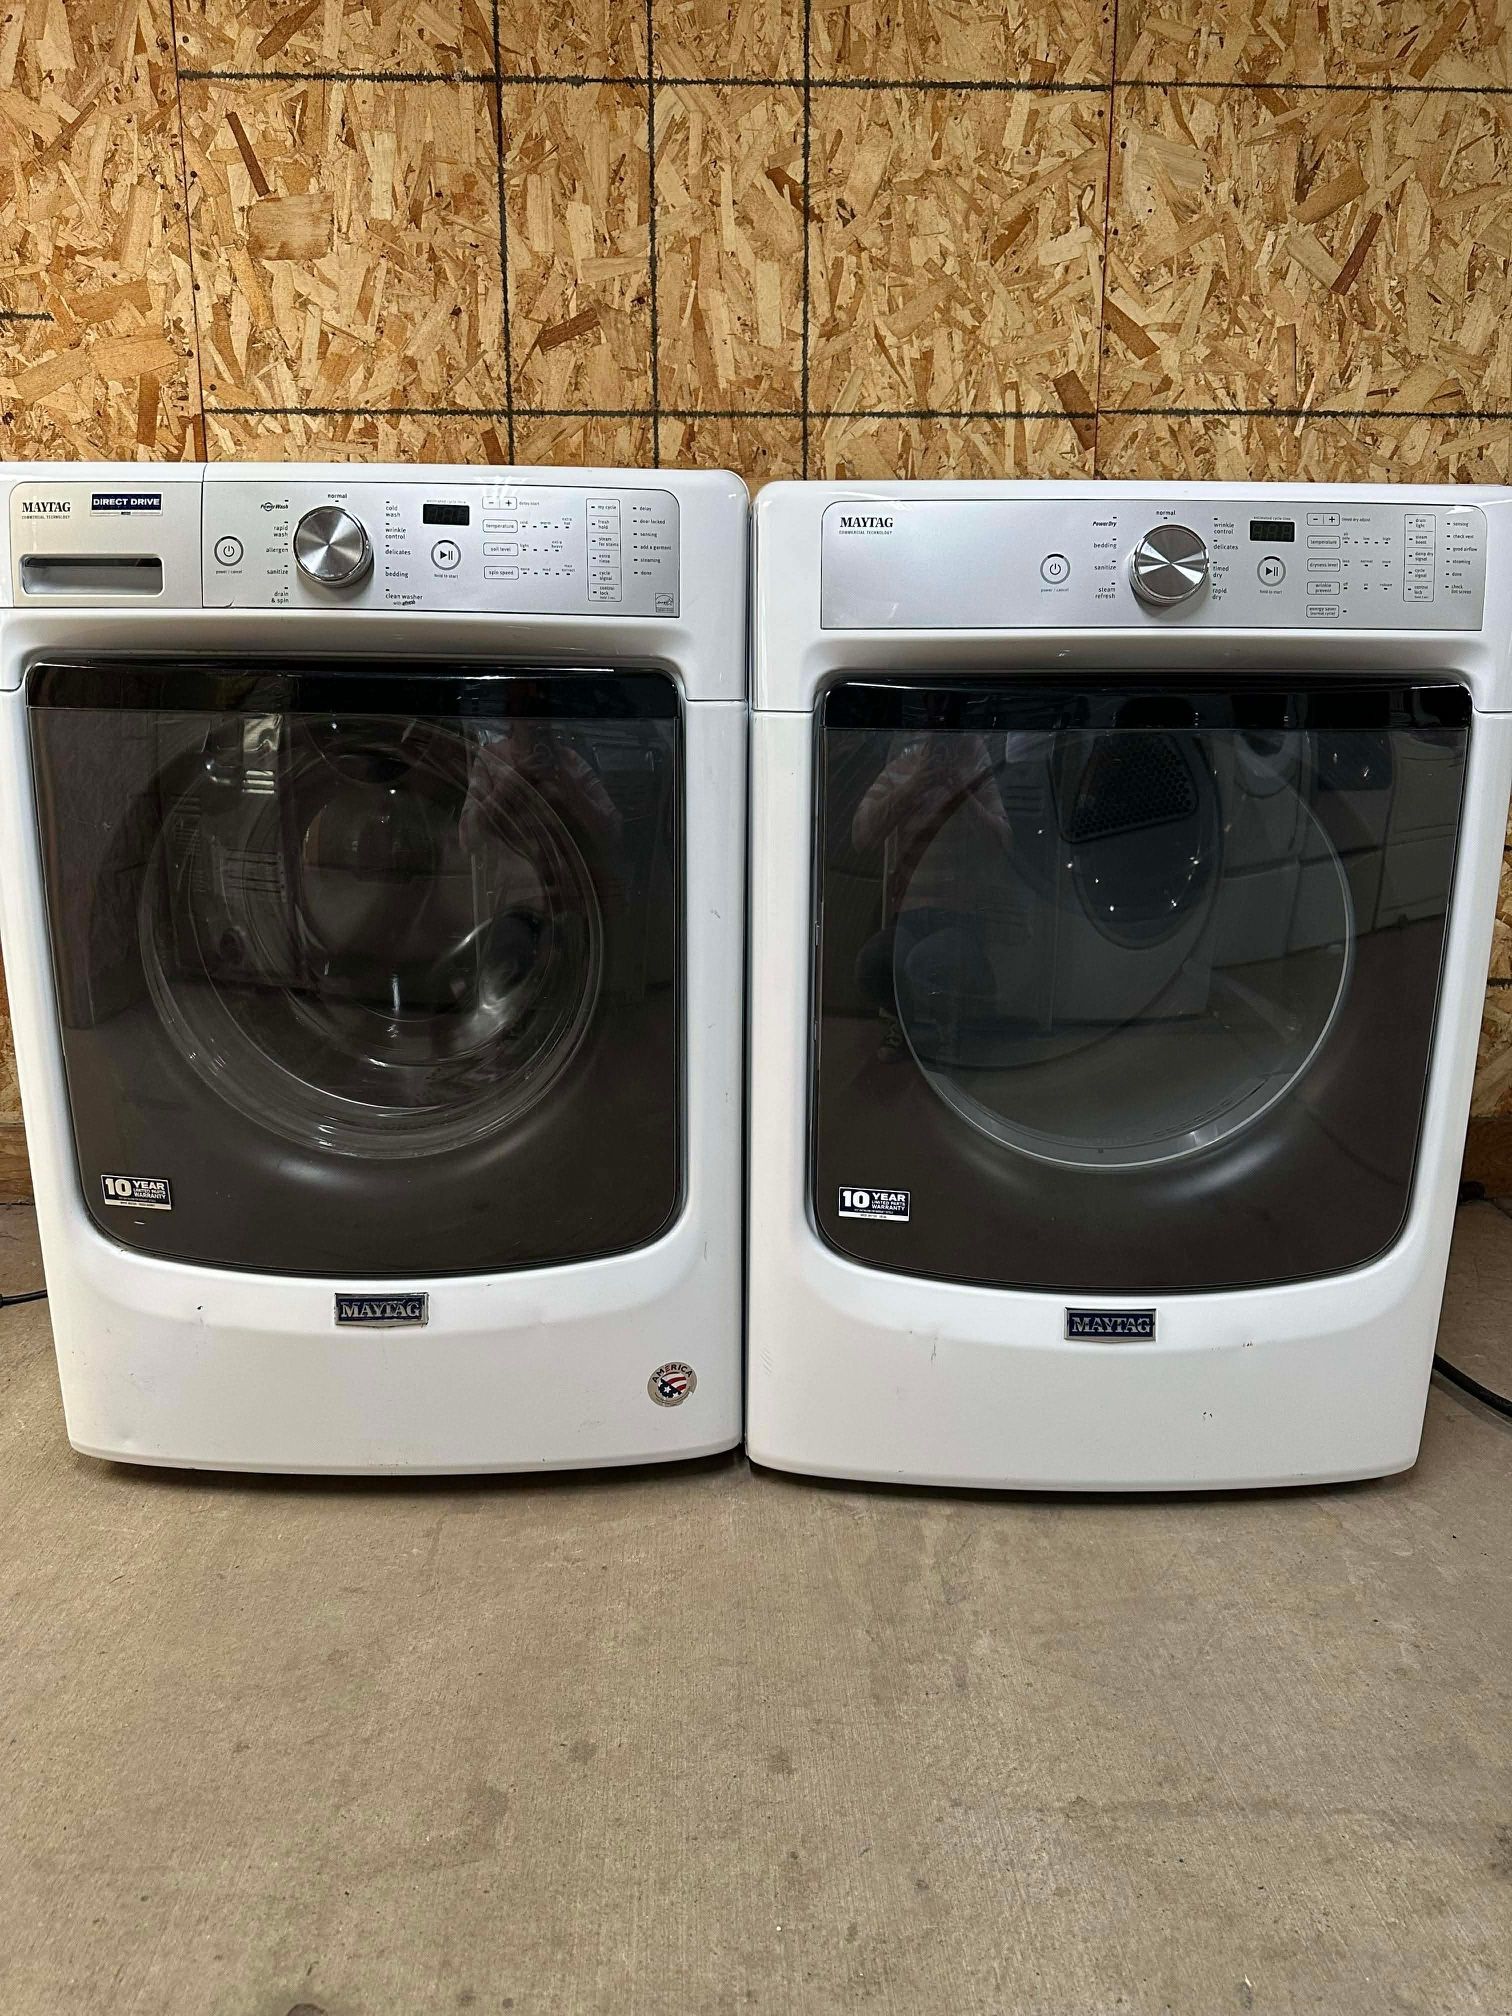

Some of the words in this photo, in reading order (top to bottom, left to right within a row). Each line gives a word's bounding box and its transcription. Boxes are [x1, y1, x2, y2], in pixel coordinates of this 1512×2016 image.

[22, 502, 71, 512] MAYTAG
[93, 498, 128, 506] DIRECT
[130, 498, 160, 506] DRIVE
[840, 516, 894, 528] MAYTAG
[385, 571, 408, 579] bedding
[105, 1178, 132, 1197] 10
[132, 1180, 165, 1190] YEAR
[842, 1190, 870, 1208] 10
[872, 1192, 906, 1202] YEAR
[340, 1300, 420, 1318] MAYTAG
[1071, 1316, 1151, 1333] MAYTAG
[652, 1364, 693, 1384] AMERICA
